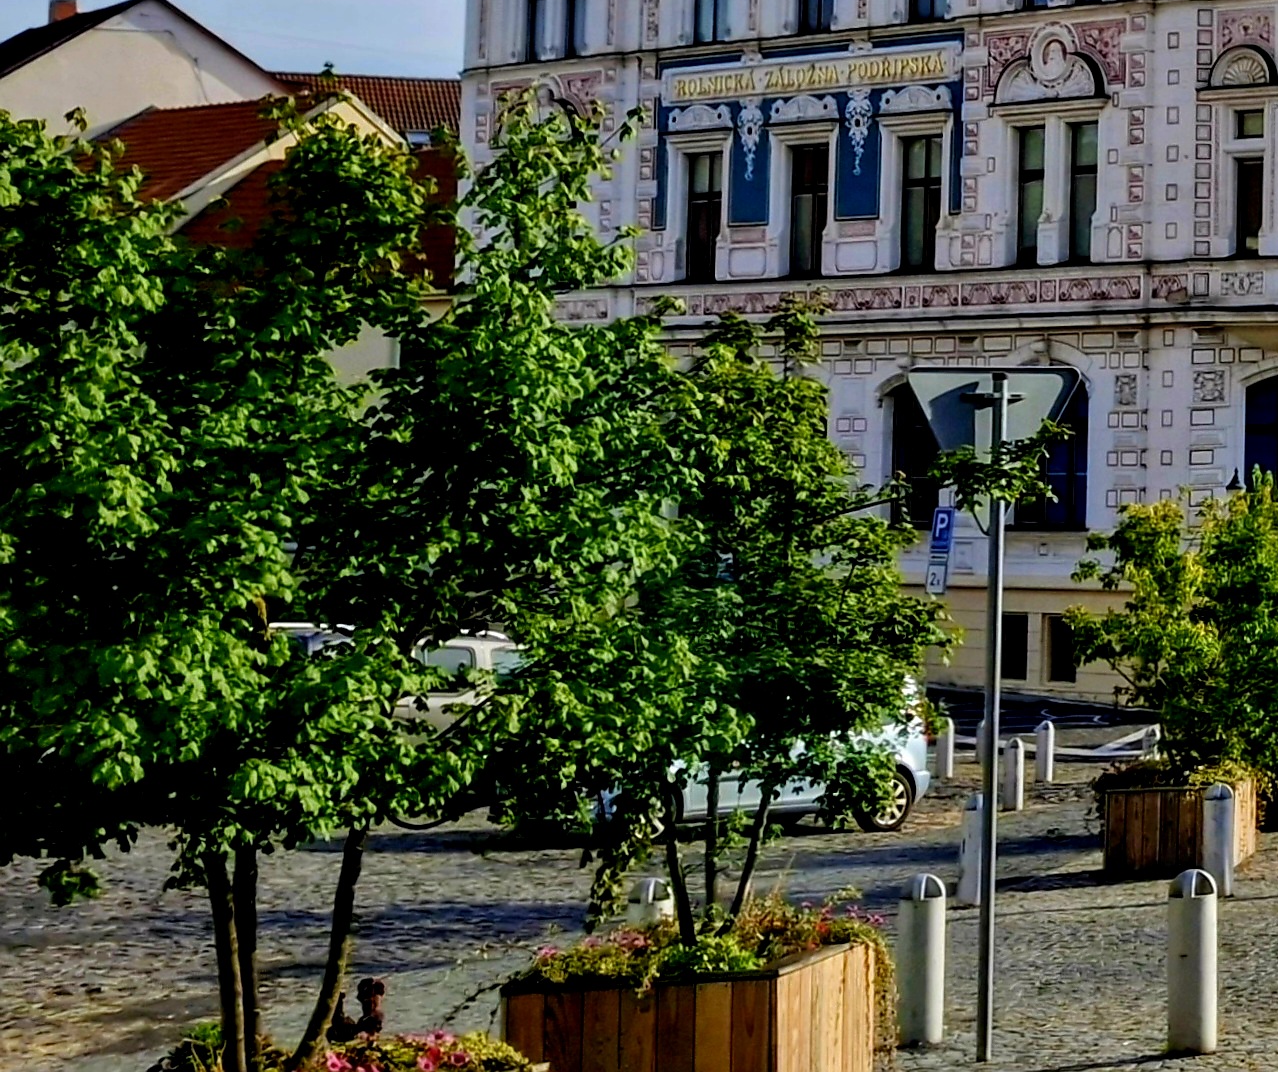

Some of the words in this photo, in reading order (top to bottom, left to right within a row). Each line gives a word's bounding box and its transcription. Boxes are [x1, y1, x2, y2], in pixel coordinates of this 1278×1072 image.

[677, 68, 756, 96] ROLNICKÁ
[765, 63, 840, 90] ZÁLOŽNA
[847, 50, 945, 80] PODŘIPSKÁ
[936, 513, 949, 537] P
